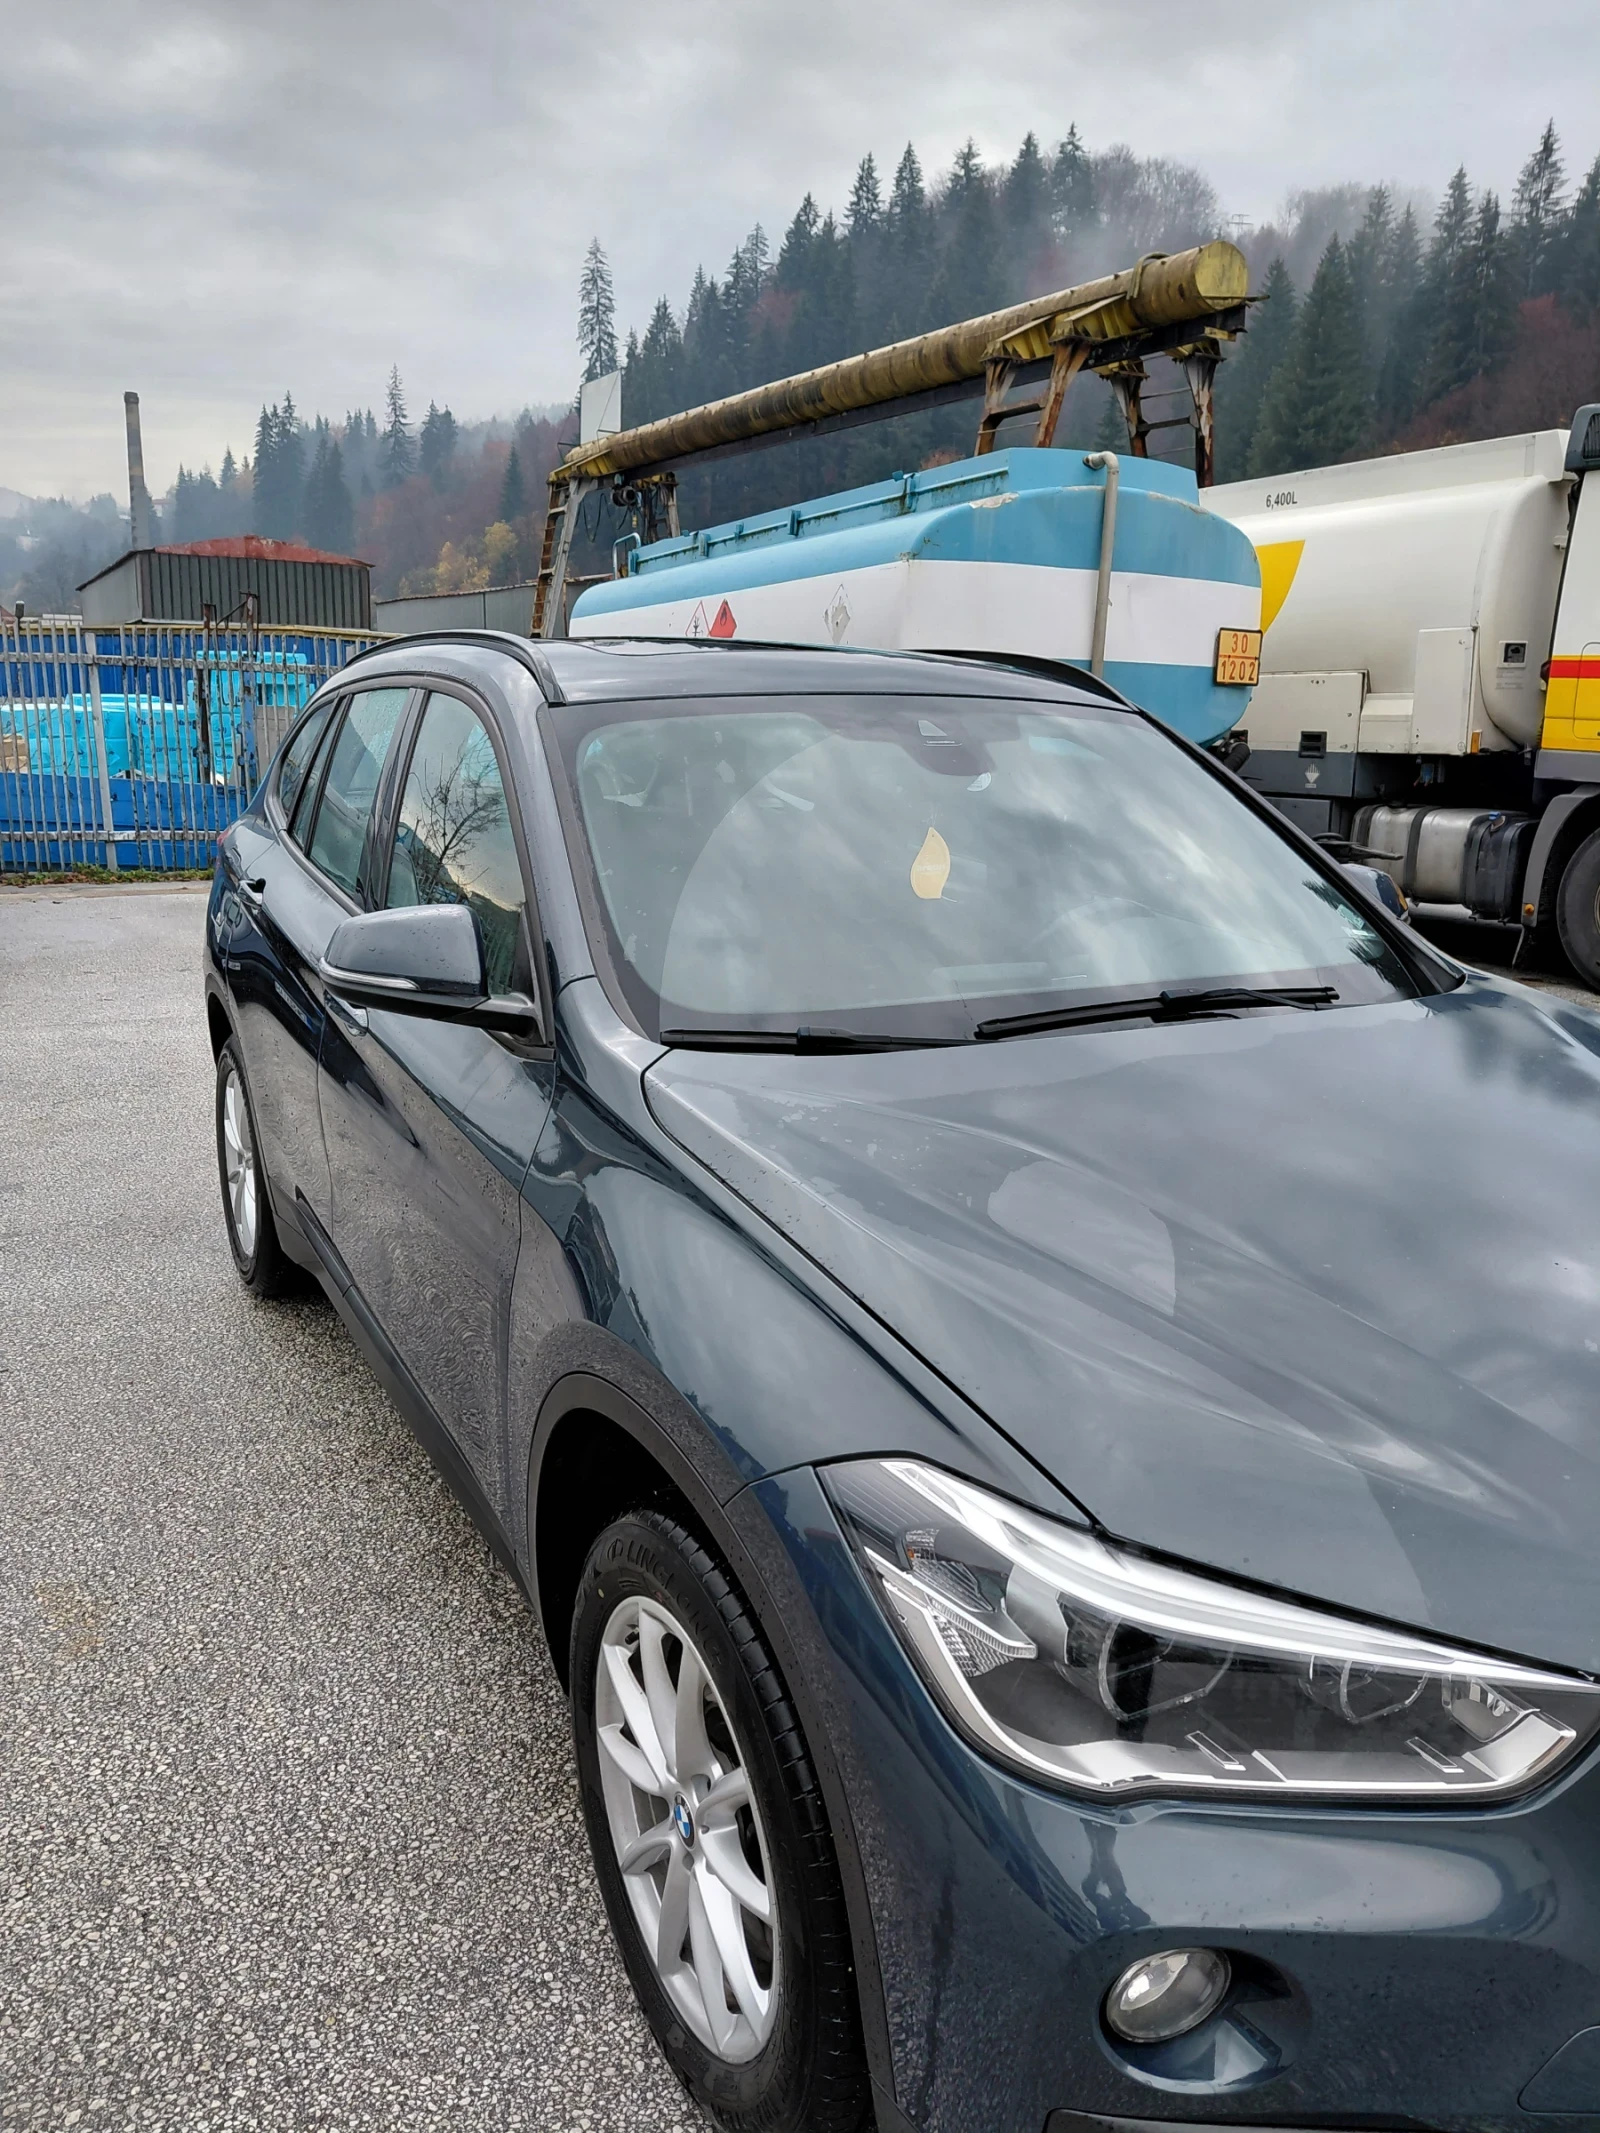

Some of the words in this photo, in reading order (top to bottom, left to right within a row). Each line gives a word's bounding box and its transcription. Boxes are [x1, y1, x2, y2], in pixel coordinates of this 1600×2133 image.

[1265, 490, 1298, 510] 6,400L
[1231, 633, 1248, 653] 30
[1221, 660, 1256, 681] 1202
